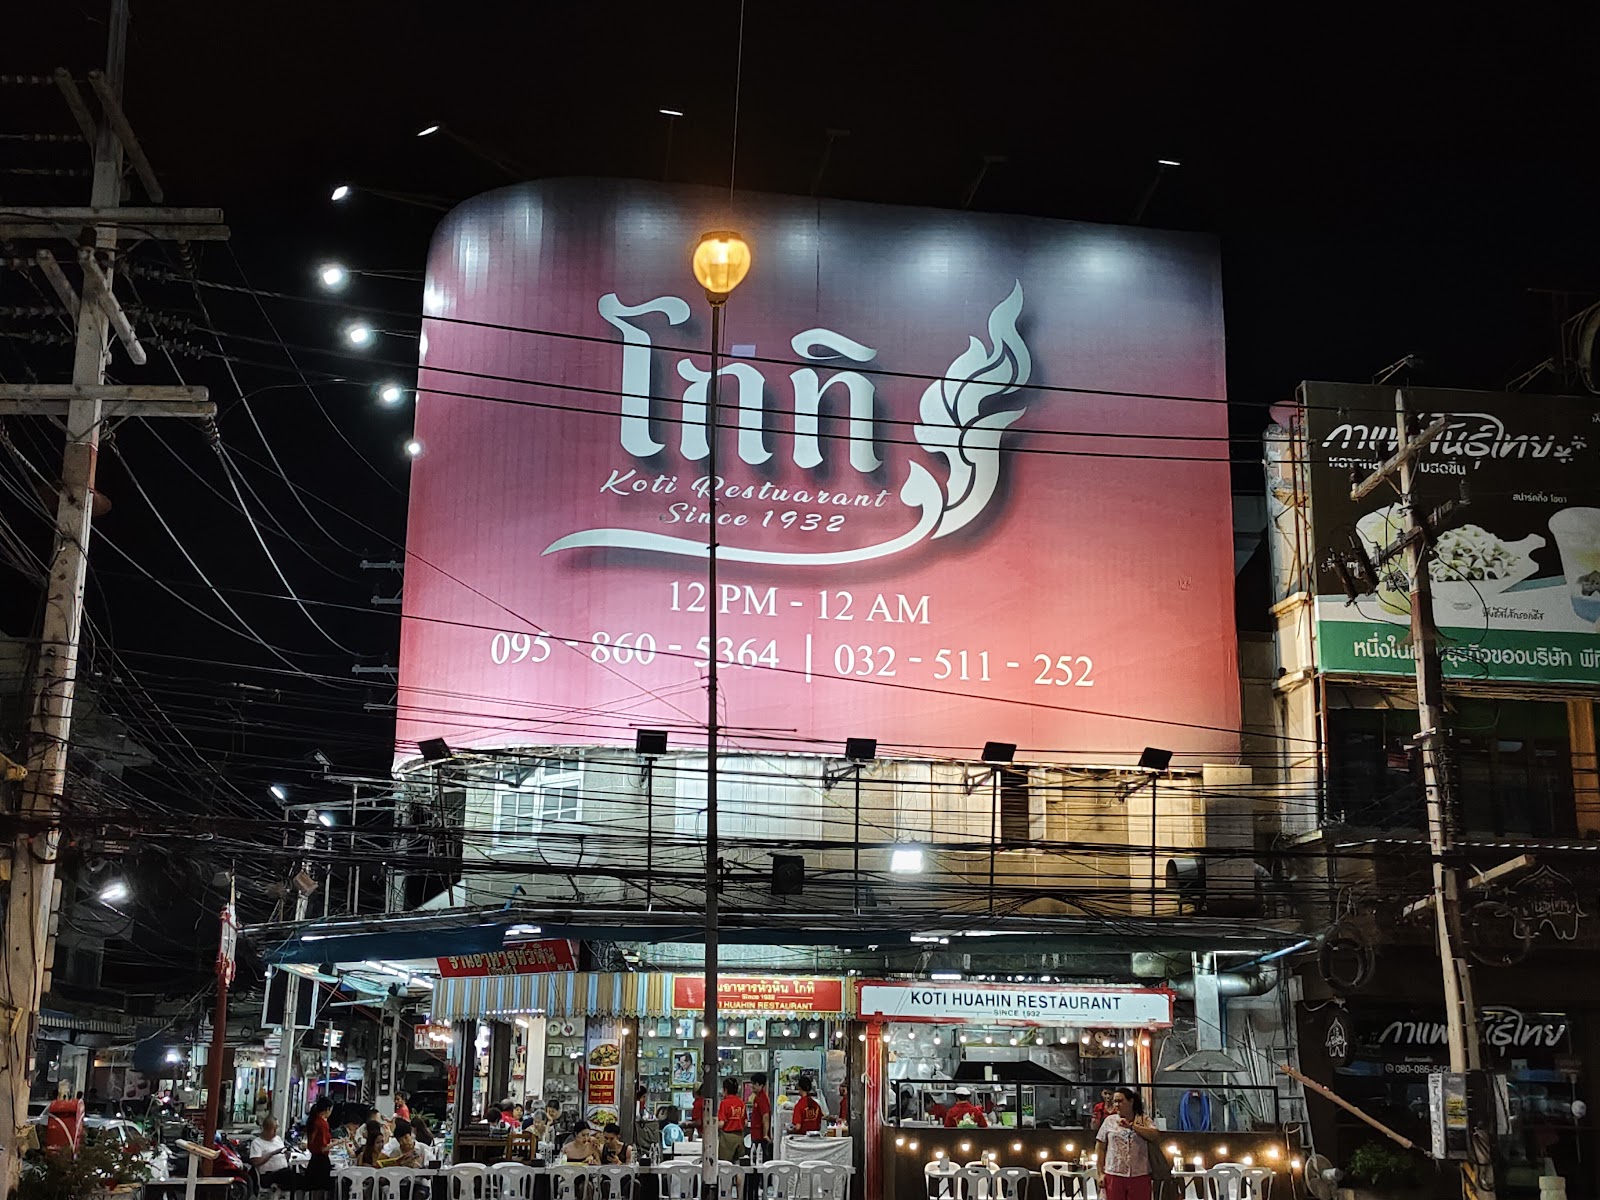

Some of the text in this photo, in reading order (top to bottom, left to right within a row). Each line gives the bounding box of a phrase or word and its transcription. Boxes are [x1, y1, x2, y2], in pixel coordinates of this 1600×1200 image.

[598, 293, 884, 473] โกทิ
[600, 469, 678, 496] Koti
[664, 502, 846, 532] Since 1932
[670, 581, 706, 613] 12
[719, 584, 779, 617] PM
[817, 590, 855, 621] 12
[865, 593, 932, 625] AM
[491, 631, 552, 665] 095
[590, 631, 657, 665] 860
[694, 636, 780, 669] 5364
[834, 644, 897, 677] 032
[933, 648, 992, 682] 511
[1033, 653, 1096, 688] 252
[724, 1001, 756, 1010] HUAHIN
[757, 1002, 814, 1011] RESTAURANT
[911, 991, 1121, 1010] KOTI HUAHIN RESTAURANT
[993, 1009, 1041, 1018] SINCE 1932
[590, 1071, 614, 1082] KOTI
